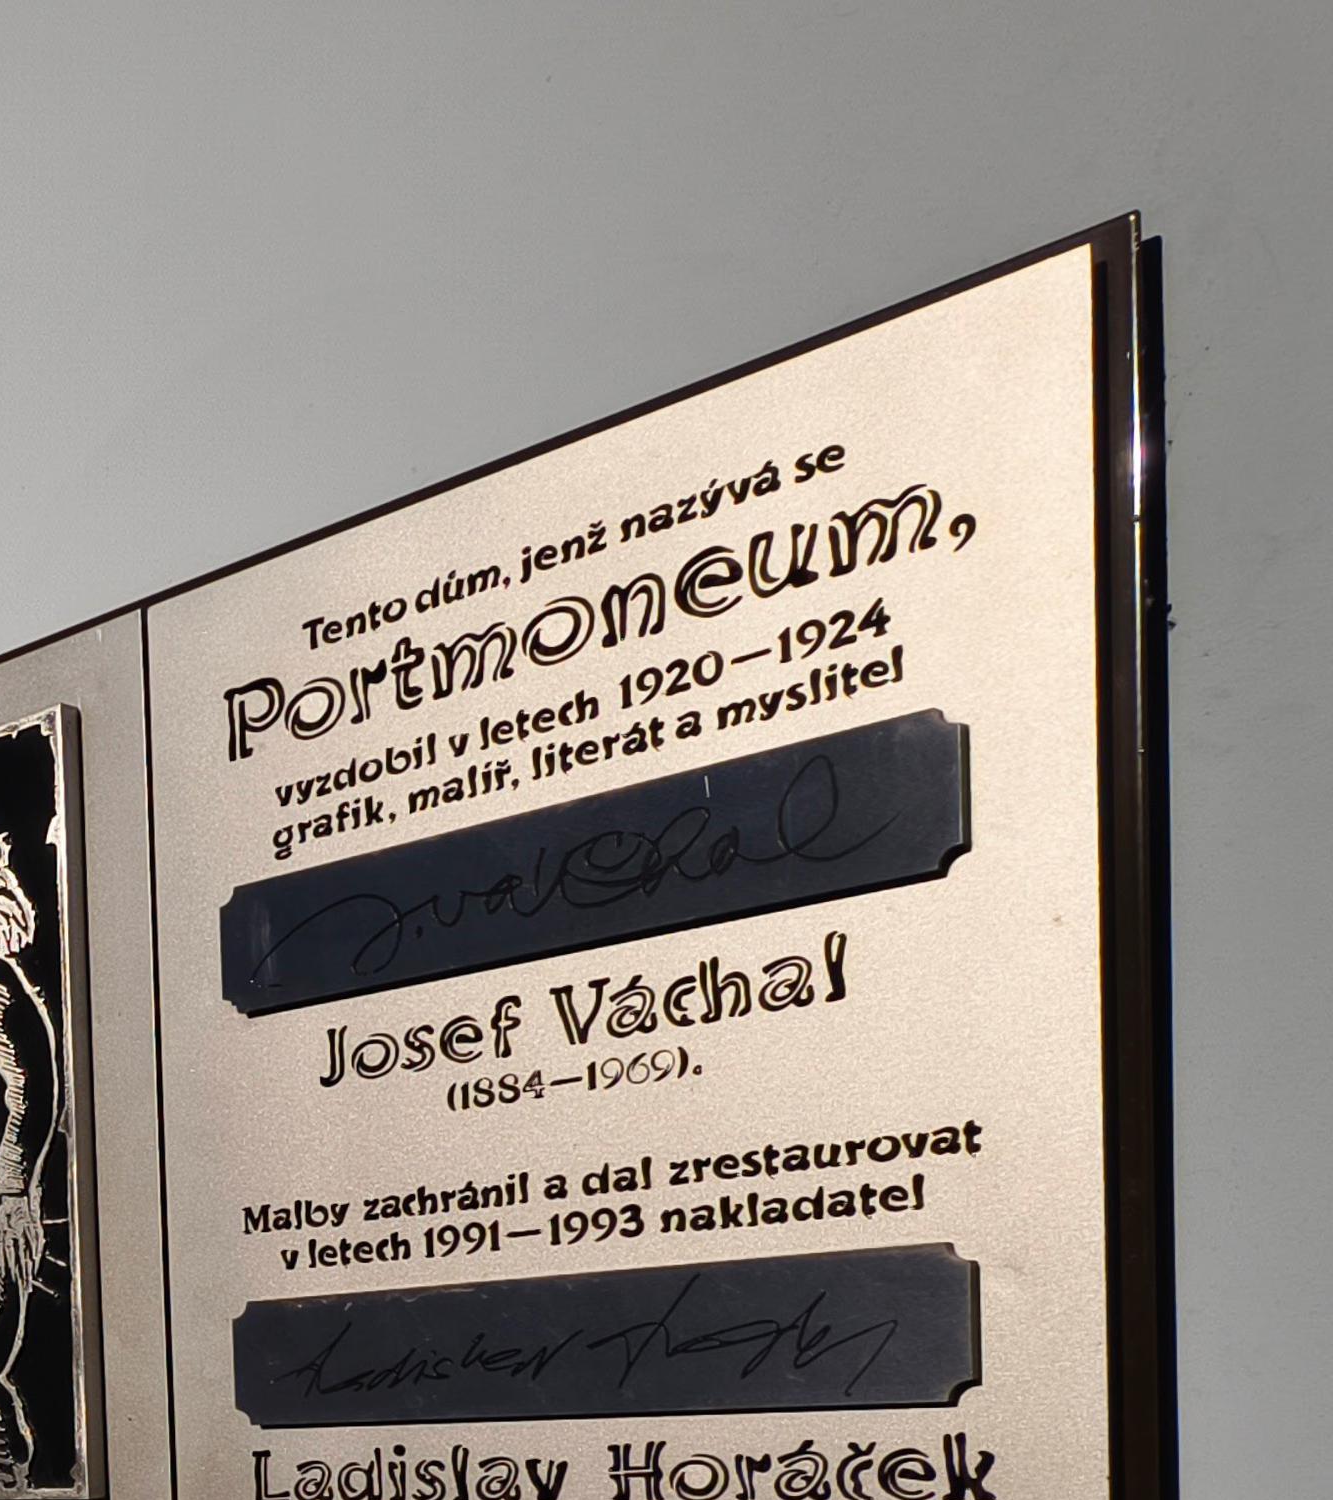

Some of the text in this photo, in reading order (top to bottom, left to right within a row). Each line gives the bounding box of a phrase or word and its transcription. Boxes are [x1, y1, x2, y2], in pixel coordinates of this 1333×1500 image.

[222, 484, 977, 763] Portmoneum,
[301, 444, 846, 651] Tento dům, jenž nazývá se
[272, 644, 904, 861] grafik, malíř, literát a myslitel
[274, 732, 437, 808] vyzdobil
[448, 732, 470, 758] v
[479, 690, 600, 751] letech
[319, 930, 848, 1088] Josef Váchal
[241, 1199, 350, 1235] Malby
[363, 1171, 529, 1222] zachránil
[543, 1174, 569, 1201] a
[581, 1156, 652, 1197] dal
[280, 1249, 300, 1271] v
[308, 1231, 412, 1269] letech
[660, 1172, 925, 1234] nakladatel
